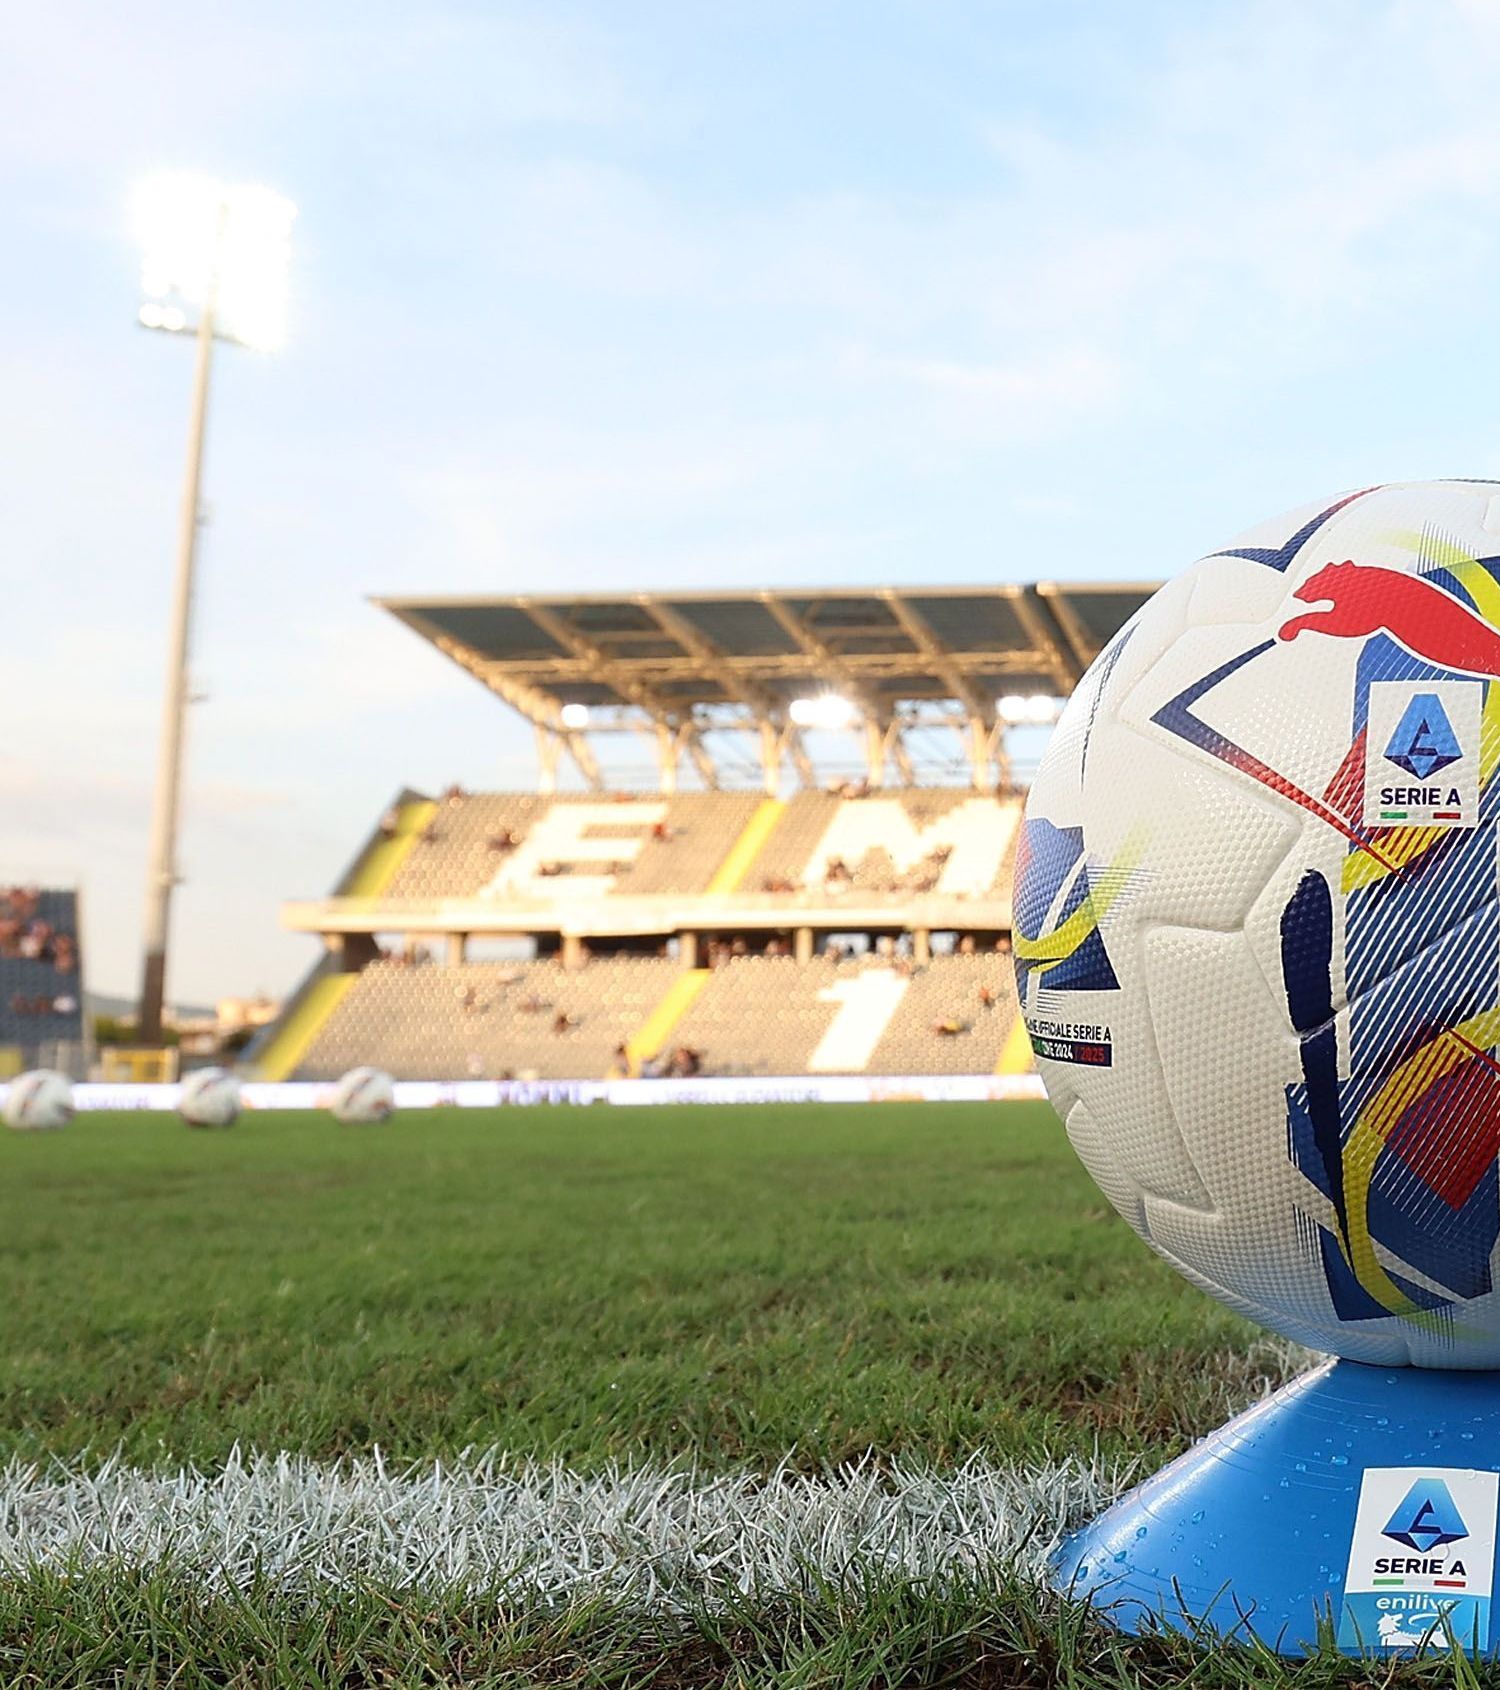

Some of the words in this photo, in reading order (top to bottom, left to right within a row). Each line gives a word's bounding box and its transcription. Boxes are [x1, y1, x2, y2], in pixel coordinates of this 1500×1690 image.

[1380, 787, 1441, 806] SERIE
[1445, 788, 1462, 806] A
[1072, 1023, 1102, 1041] SERIE
[1103, 1026, 1112, 1042] A
[1054, 1041, 1074, 1060] 2024
[1080, 1046, 1105, 1063] 2025
[1373, 1558, 1444, 1575] SERIE
[1448, 1560, 1467, 1576] A
